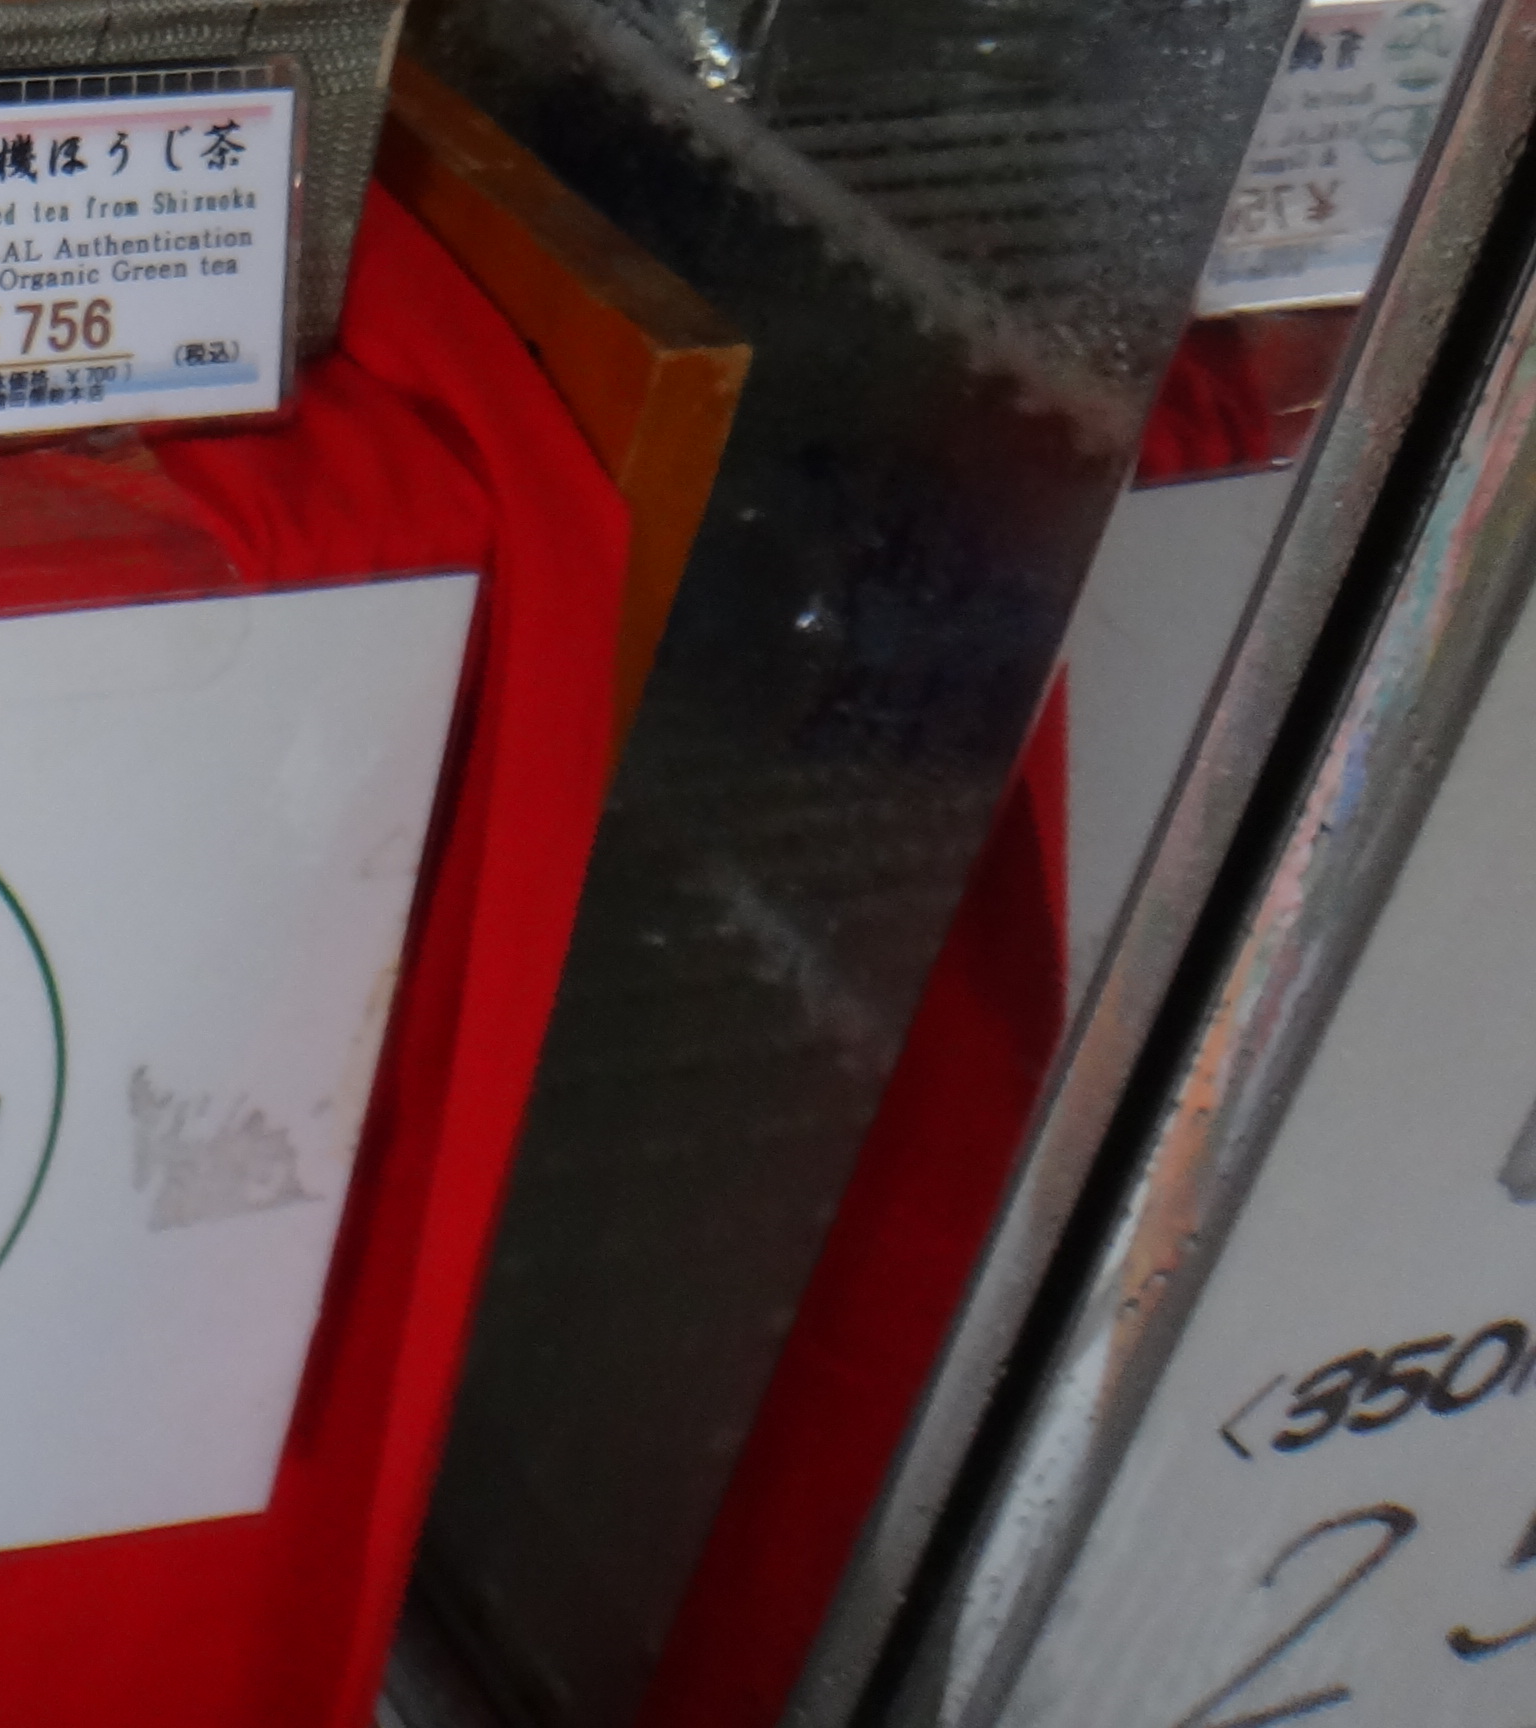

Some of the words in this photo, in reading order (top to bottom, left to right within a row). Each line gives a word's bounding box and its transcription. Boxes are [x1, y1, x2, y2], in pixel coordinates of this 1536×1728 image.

[34, 201, 70, 224] tea
[86, 195, 138, 220] from
[55, 228, 253, 262] Authentication
[113, 261, 189, 285] Green
[200, 256, 238, 276] tea
